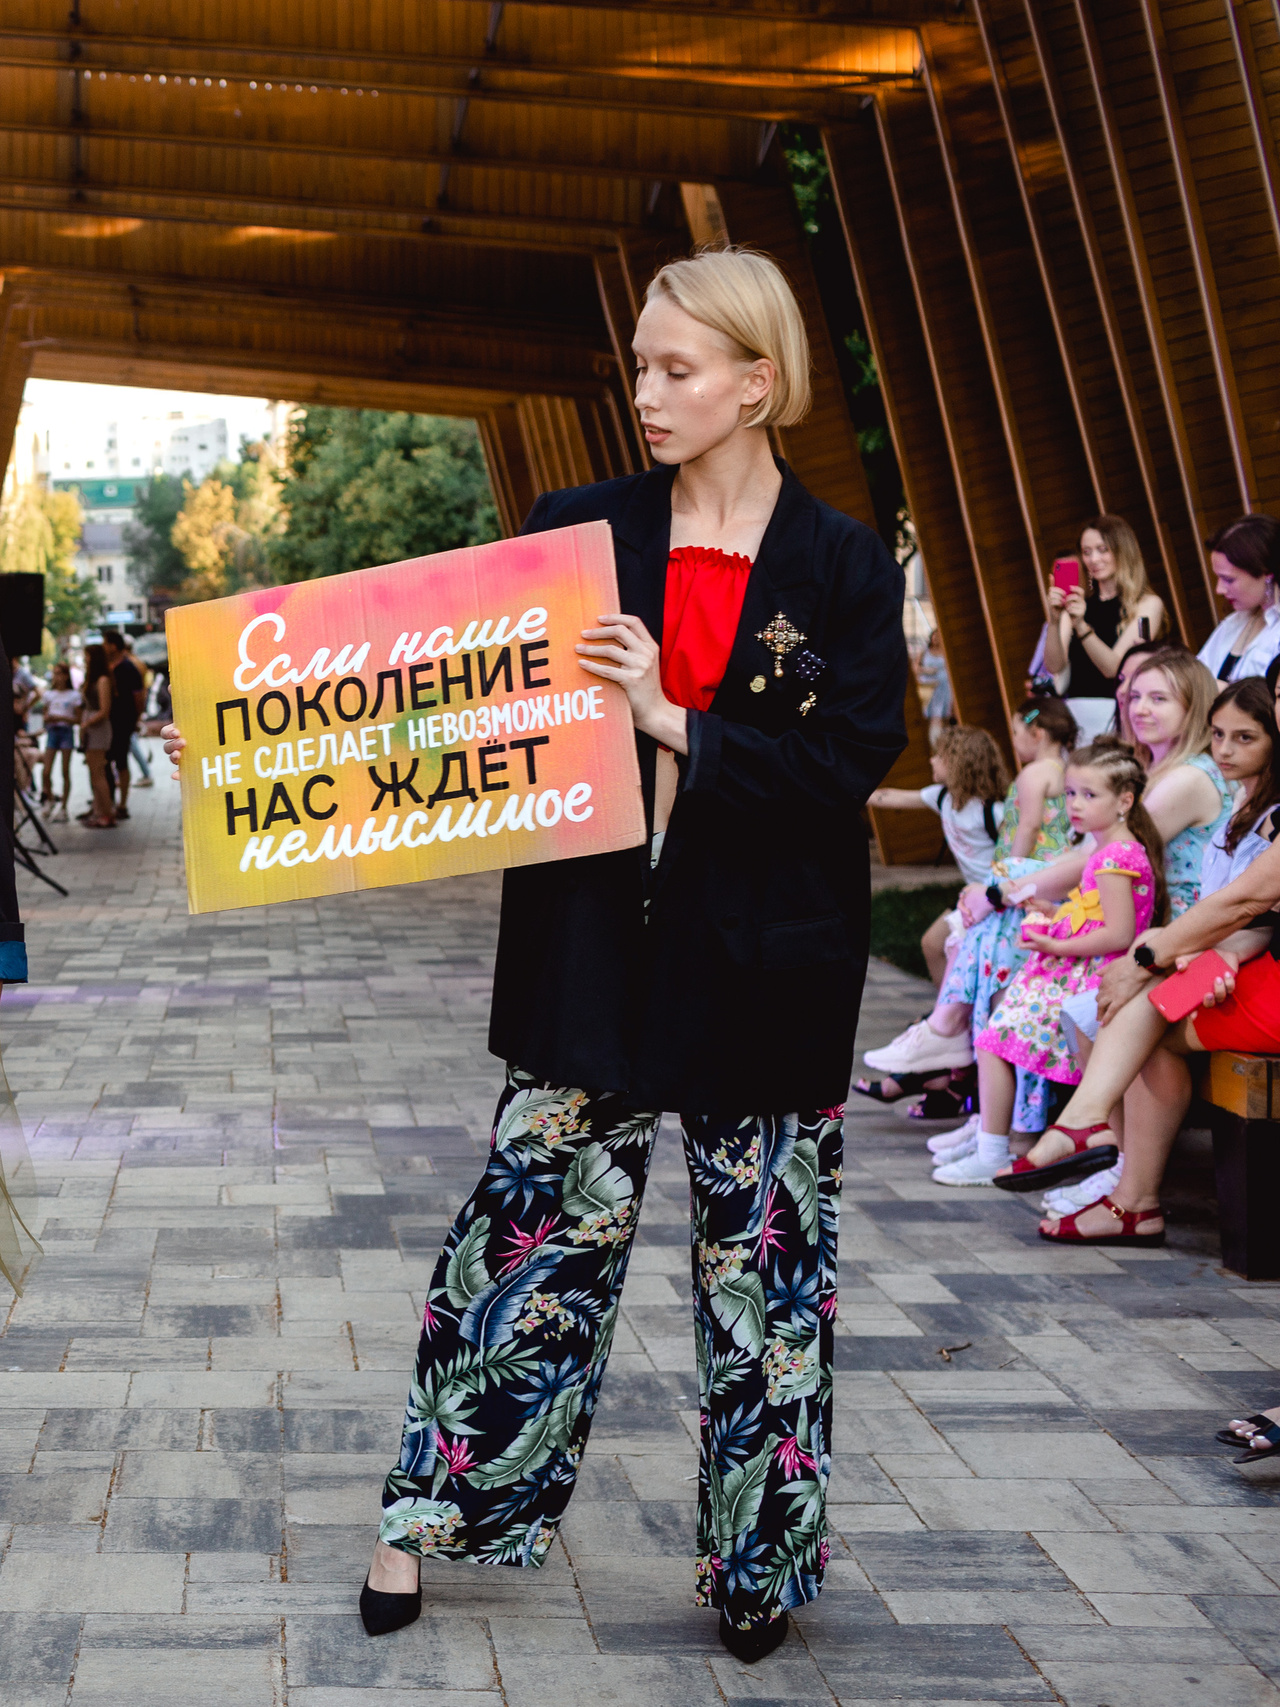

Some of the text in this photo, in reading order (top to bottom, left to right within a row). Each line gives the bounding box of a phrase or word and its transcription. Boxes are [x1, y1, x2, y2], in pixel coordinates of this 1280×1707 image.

[215, 640, 551, 746] ПОКОЛЕНИЕ
[233, 607, 548, 692] Если наше
[202, 685, 605, 789] НЕ СДЕЛАЕТ НЕВОЗМОЖНОЕ
[225, 736, 550, 836] НАС ЖДЁТ
[239, 783, 594, 872] немыслимое
